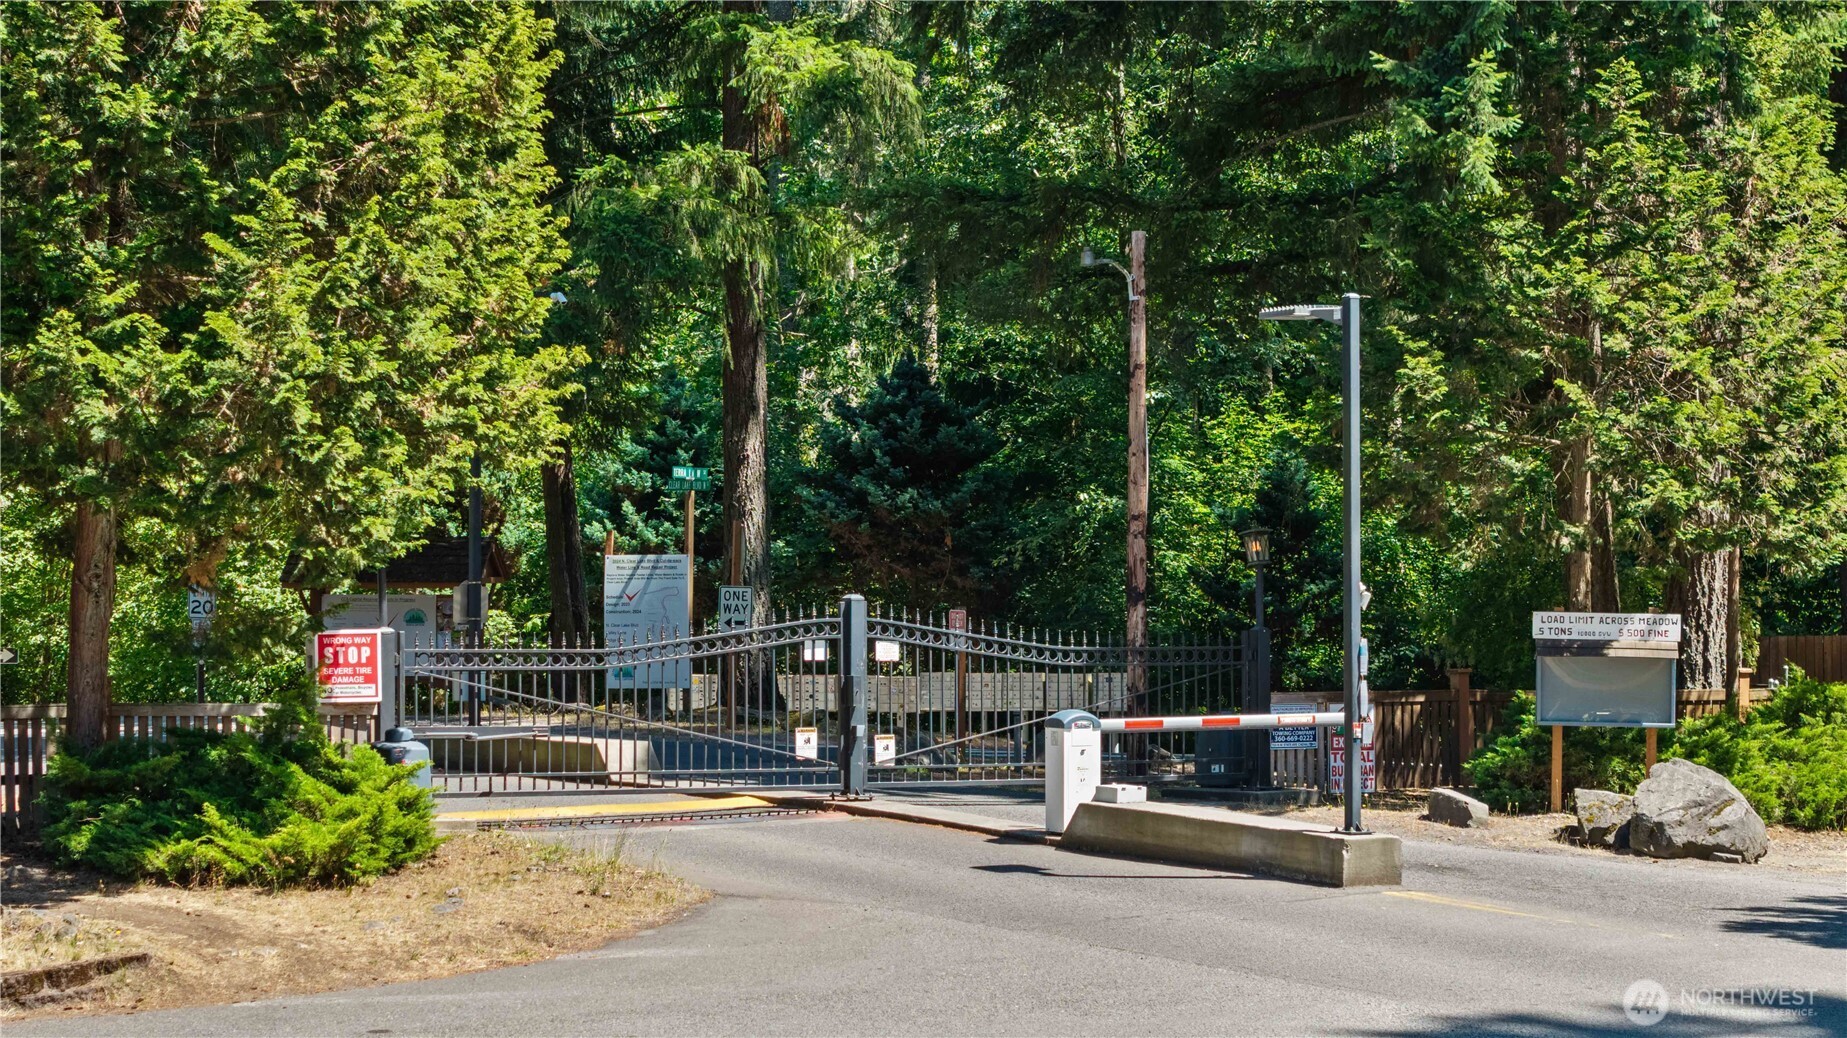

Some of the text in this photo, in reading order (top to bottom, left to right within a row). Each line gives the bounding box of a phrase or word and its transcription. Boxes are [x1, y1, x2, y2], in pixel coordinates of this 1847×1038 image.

[668, 480, 681, 490] CLEAR
[682, 480, 692, 490] LAKE
[723, 590, 748, 602] ONE
[191, 599, 214, 614] 20
[723, 603, 749, 615] WAY
[1540, 615, 1679, 626] LOAD LIMIT ACROSS MEADOW
[1547, 627, 1573, 636] TONS
[1647, 629, 1670, 638] FINE
[353, 636, 371, 644] WAY
[323, 645, 371, 664] STOP
[323, 666, 373, 675] SEVERE TIRE
[331, 675, 365, 683] DAMAGE
[1331, 751, 1374, 763] TOAL
[1331, 778, 1340, 790] IN
